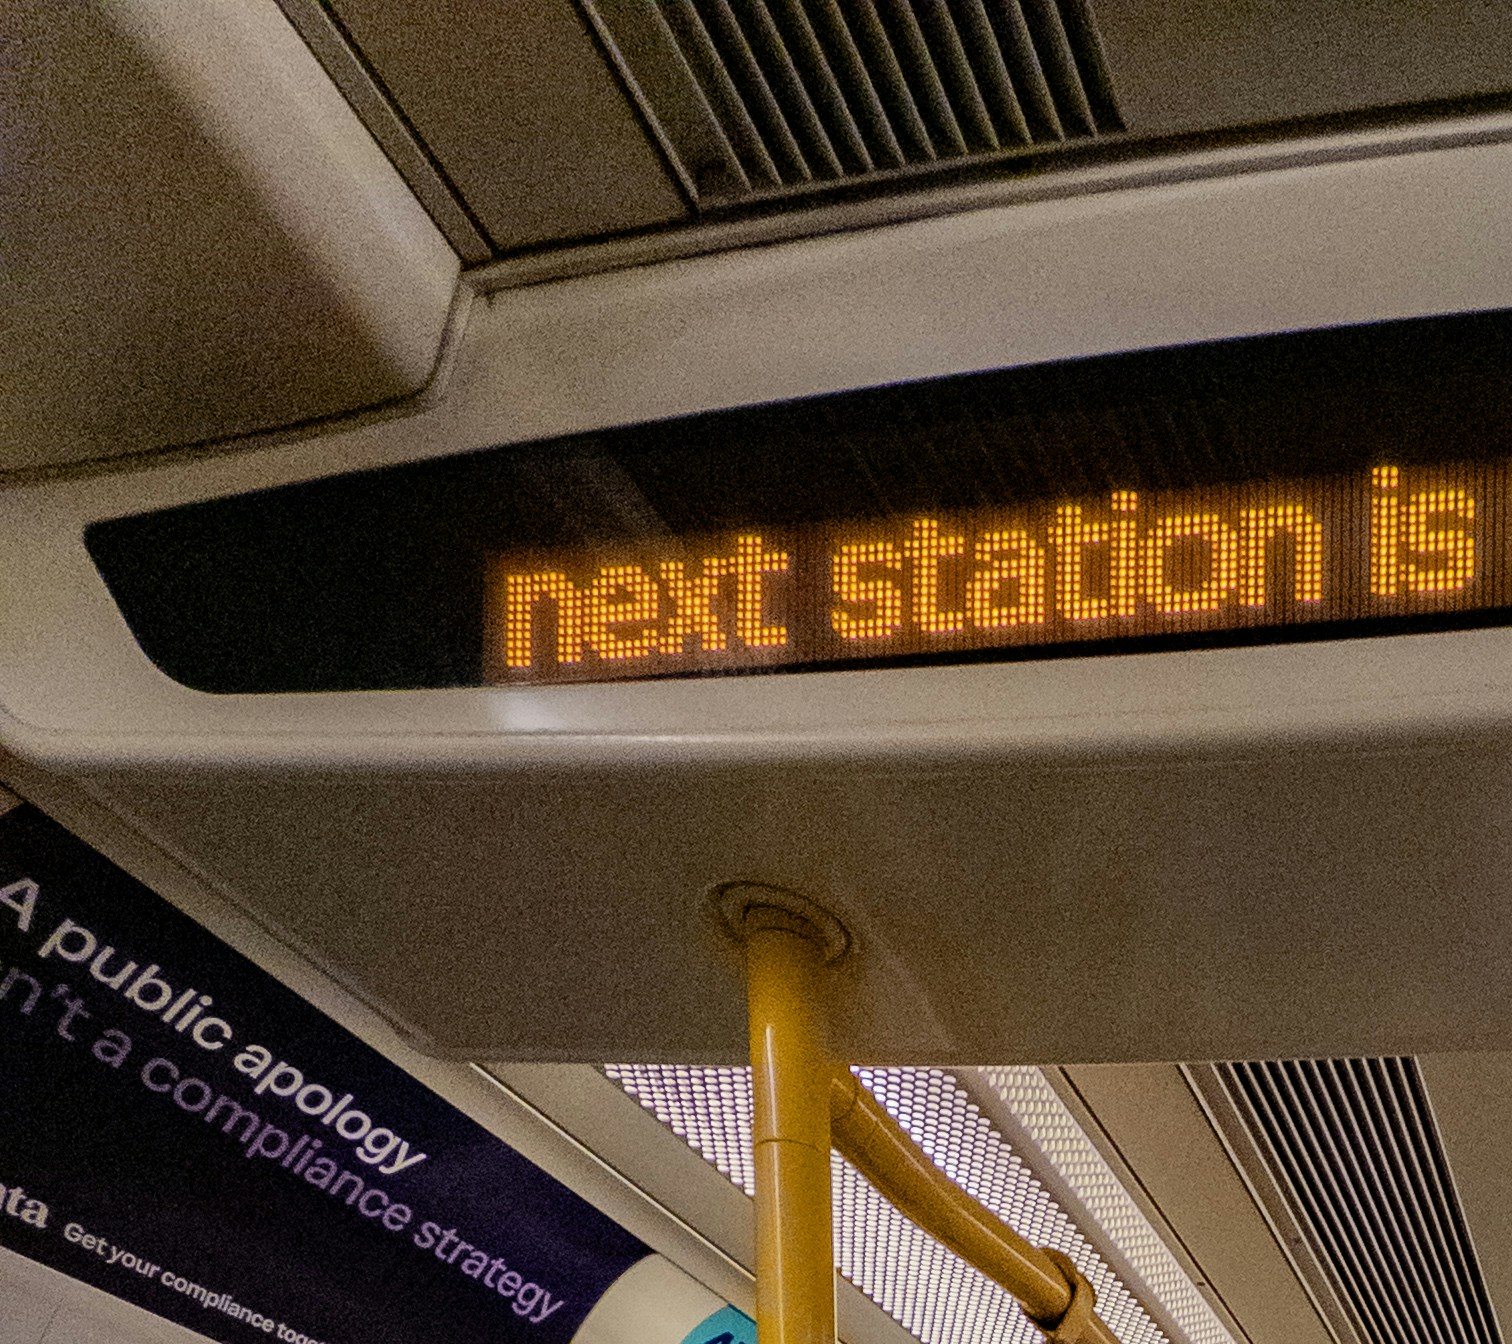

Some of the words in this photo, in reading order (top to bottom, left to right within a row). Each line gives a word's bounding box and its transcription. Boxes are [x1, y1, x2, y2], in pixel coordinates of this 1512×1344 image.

[506, 533, 790, 668] next
[832, 490, 1325, 640] station
[1370, 465, 1475, 597] is
[0, 877, 40, 932] A
[38, 917, 233, 1050] public
[233, 1044, 427, 1175] apology
[0, 1183, 49, 1229] ta
[63, 1222, 107, 1256] Get
[107, 1247, 161, 1278] your
[160, 1270, 275, 1333] compliance
[92, 1028, 133, 1069] a
[141, 1057, 412, 1231] compliance
[413, 1221, 565, 1324] strategy
